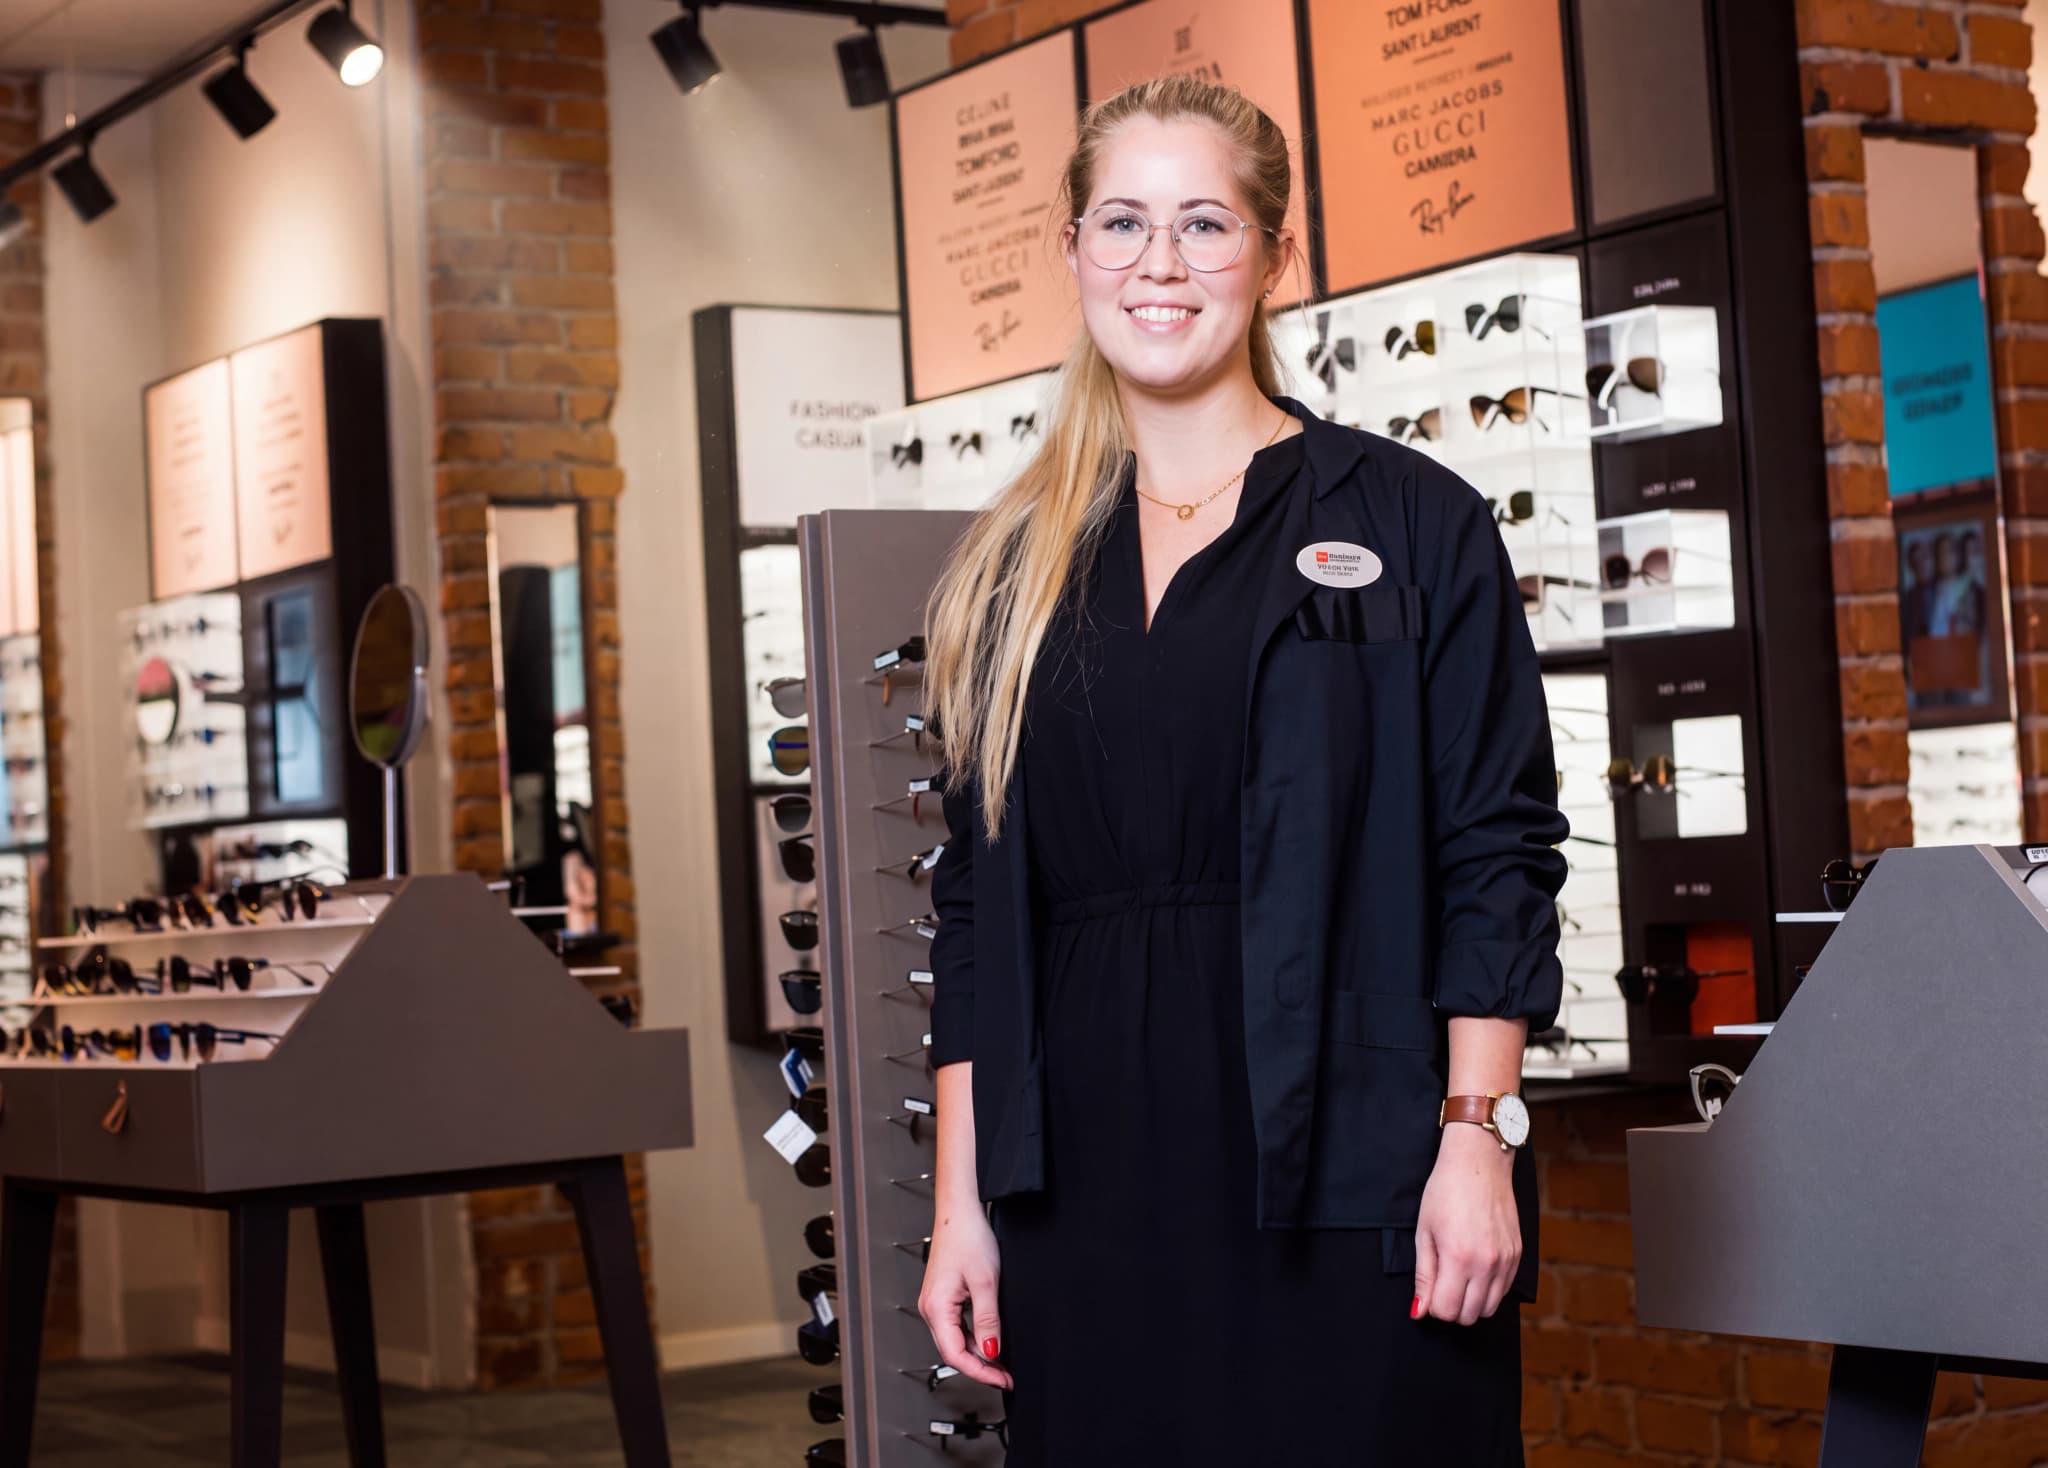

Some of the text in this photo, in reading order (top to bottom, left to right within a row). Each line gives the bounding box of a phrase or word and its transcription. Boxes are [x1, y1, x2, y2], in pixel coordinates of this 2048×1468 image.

[1385, 1, 1422, 30] TOM
[1382, 13, 1481, 61] SAINT LAURENT
[1371, 104, 1421, 131] MARC
[1429, 80, 1503, 116] JACOBS
[1392, 109, 1486, 156] GUCCI
[790, 400, 878, 420] FASHION
[795, 428, 864, 449] CASUA
